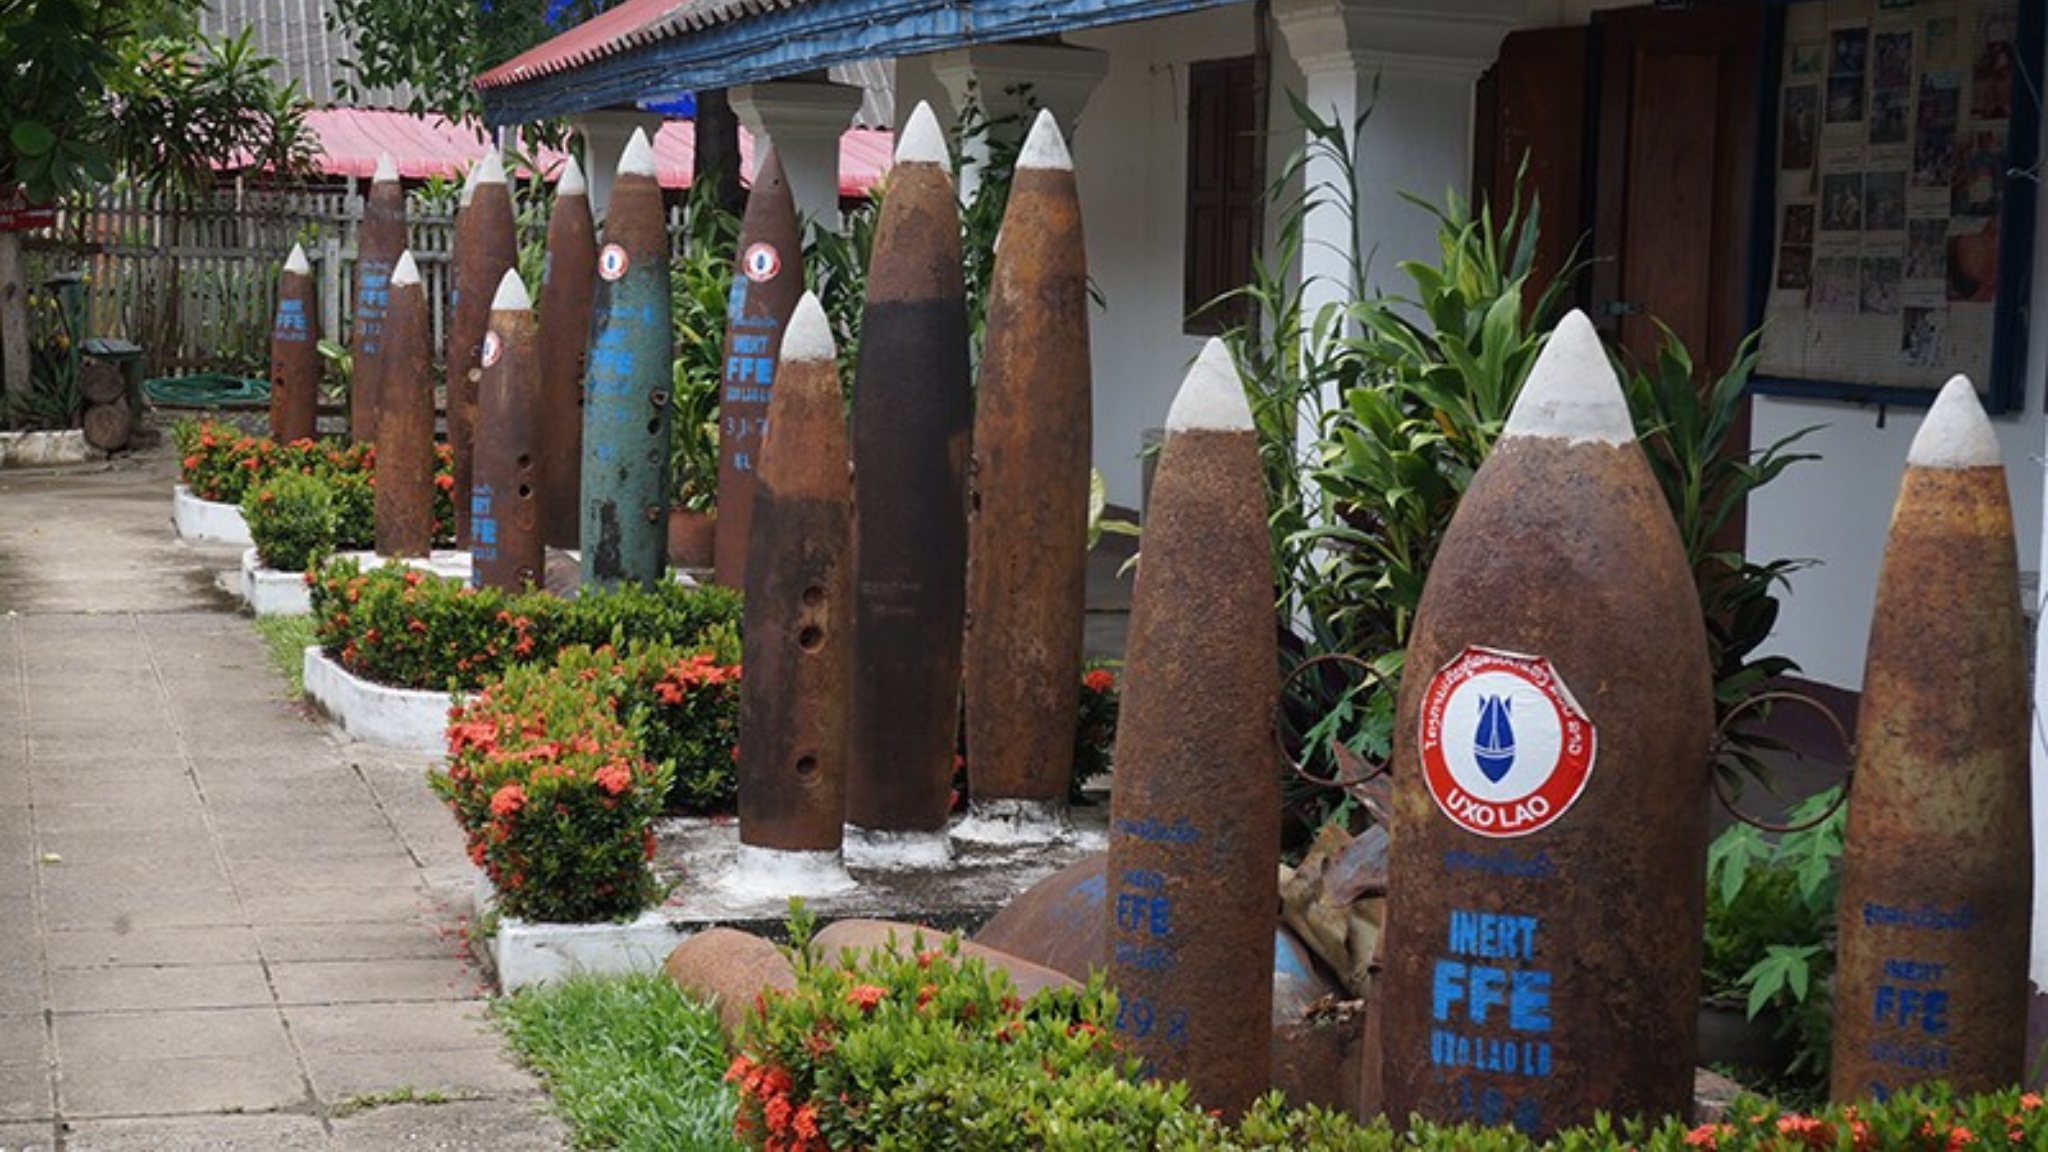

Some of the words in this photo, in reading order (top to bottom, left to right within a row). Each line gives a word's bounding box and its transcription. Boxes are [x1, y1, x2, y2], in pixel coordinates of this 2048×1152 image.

[726, 356, 773, 385] FFE
[1446, 788, 1495, 826] UXO
[1498, 795, 1550, 828] LAO
[1116, 893, 1171, 936] FFE
[1449, 909, 1538, 961] INERT
[1432, 959, 1553, 1031] FFE
[1875, 985, 1948, 1034] FFE
[1475, 1036, 1517, 1073] LAO
